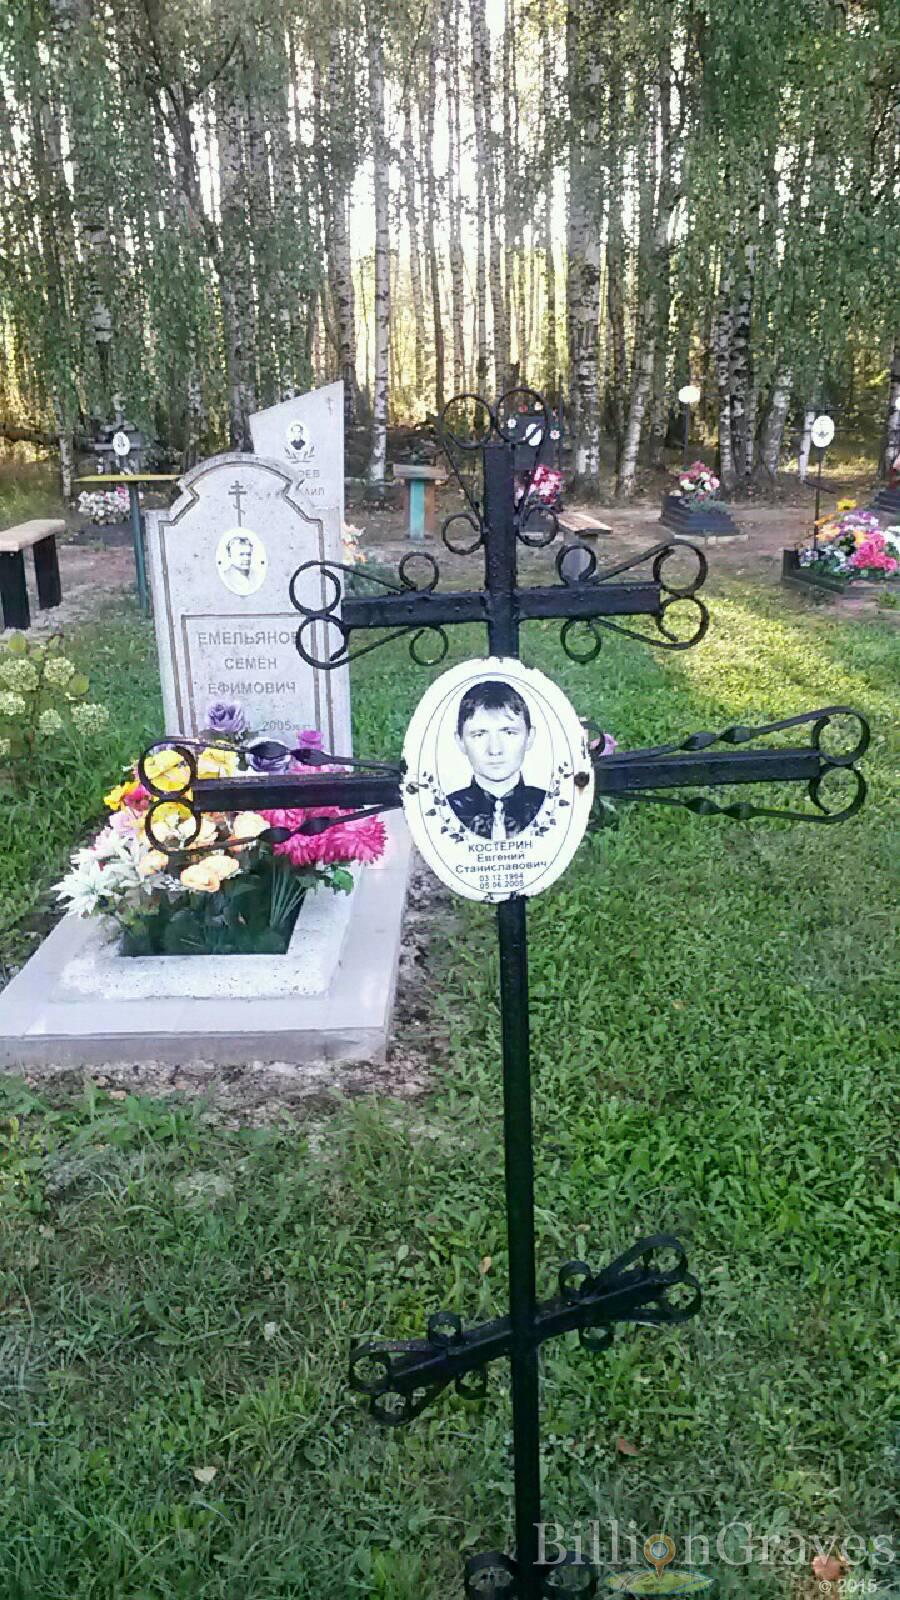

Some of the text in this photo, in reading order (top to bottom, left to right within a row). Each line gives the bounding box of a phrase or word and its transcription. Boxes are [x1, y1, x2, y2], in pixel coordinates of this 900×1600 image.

[224, 657, 277, 671] СЕМЕН
[207, 680, 296, 696] ЕФИМОВИЧ
[468, 840, 533, 853] КОСТЕРИН
[477, 851, 525, 863] Евгений
[455, 860, 547, 874] Станиславович
